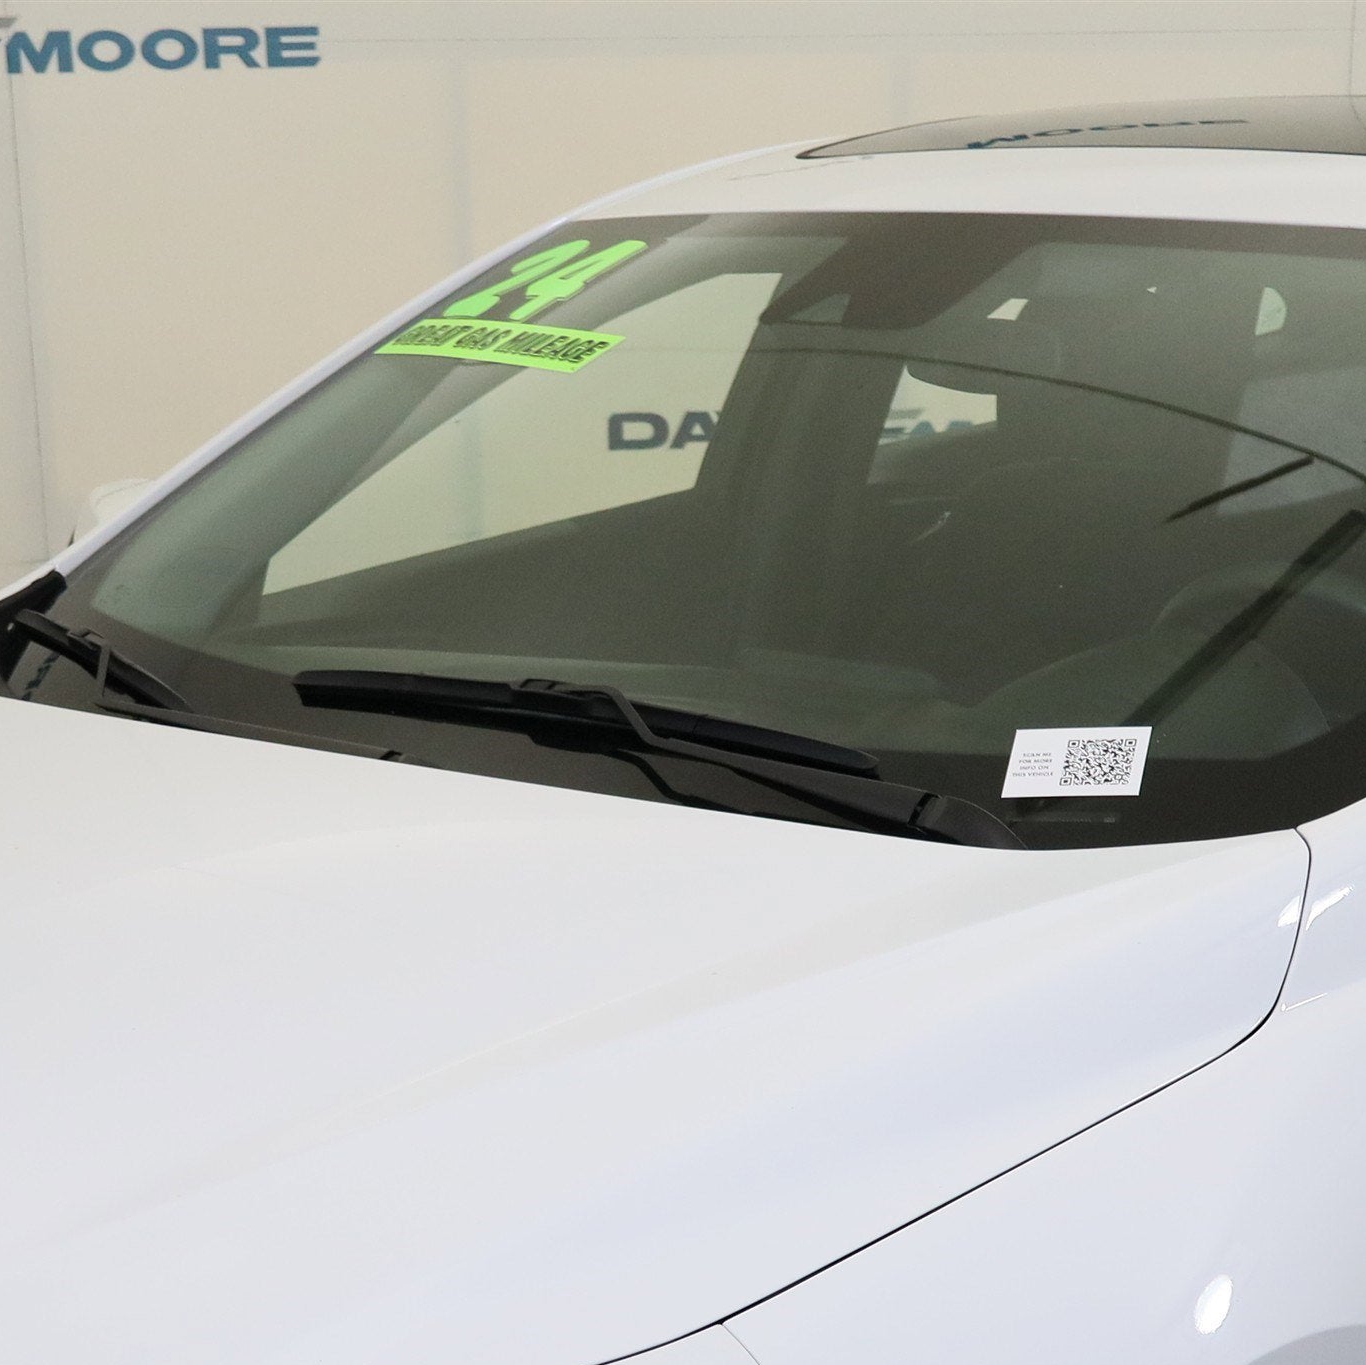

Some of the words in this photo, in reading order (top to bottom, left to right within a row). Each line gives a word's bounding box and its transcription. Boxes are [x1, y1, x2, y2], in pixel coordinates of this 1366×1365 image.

[6, 25, 322, 74] MOORE
[443, 239, 647, 320] 24
[492, 330, 611, 364] MILEAGE
